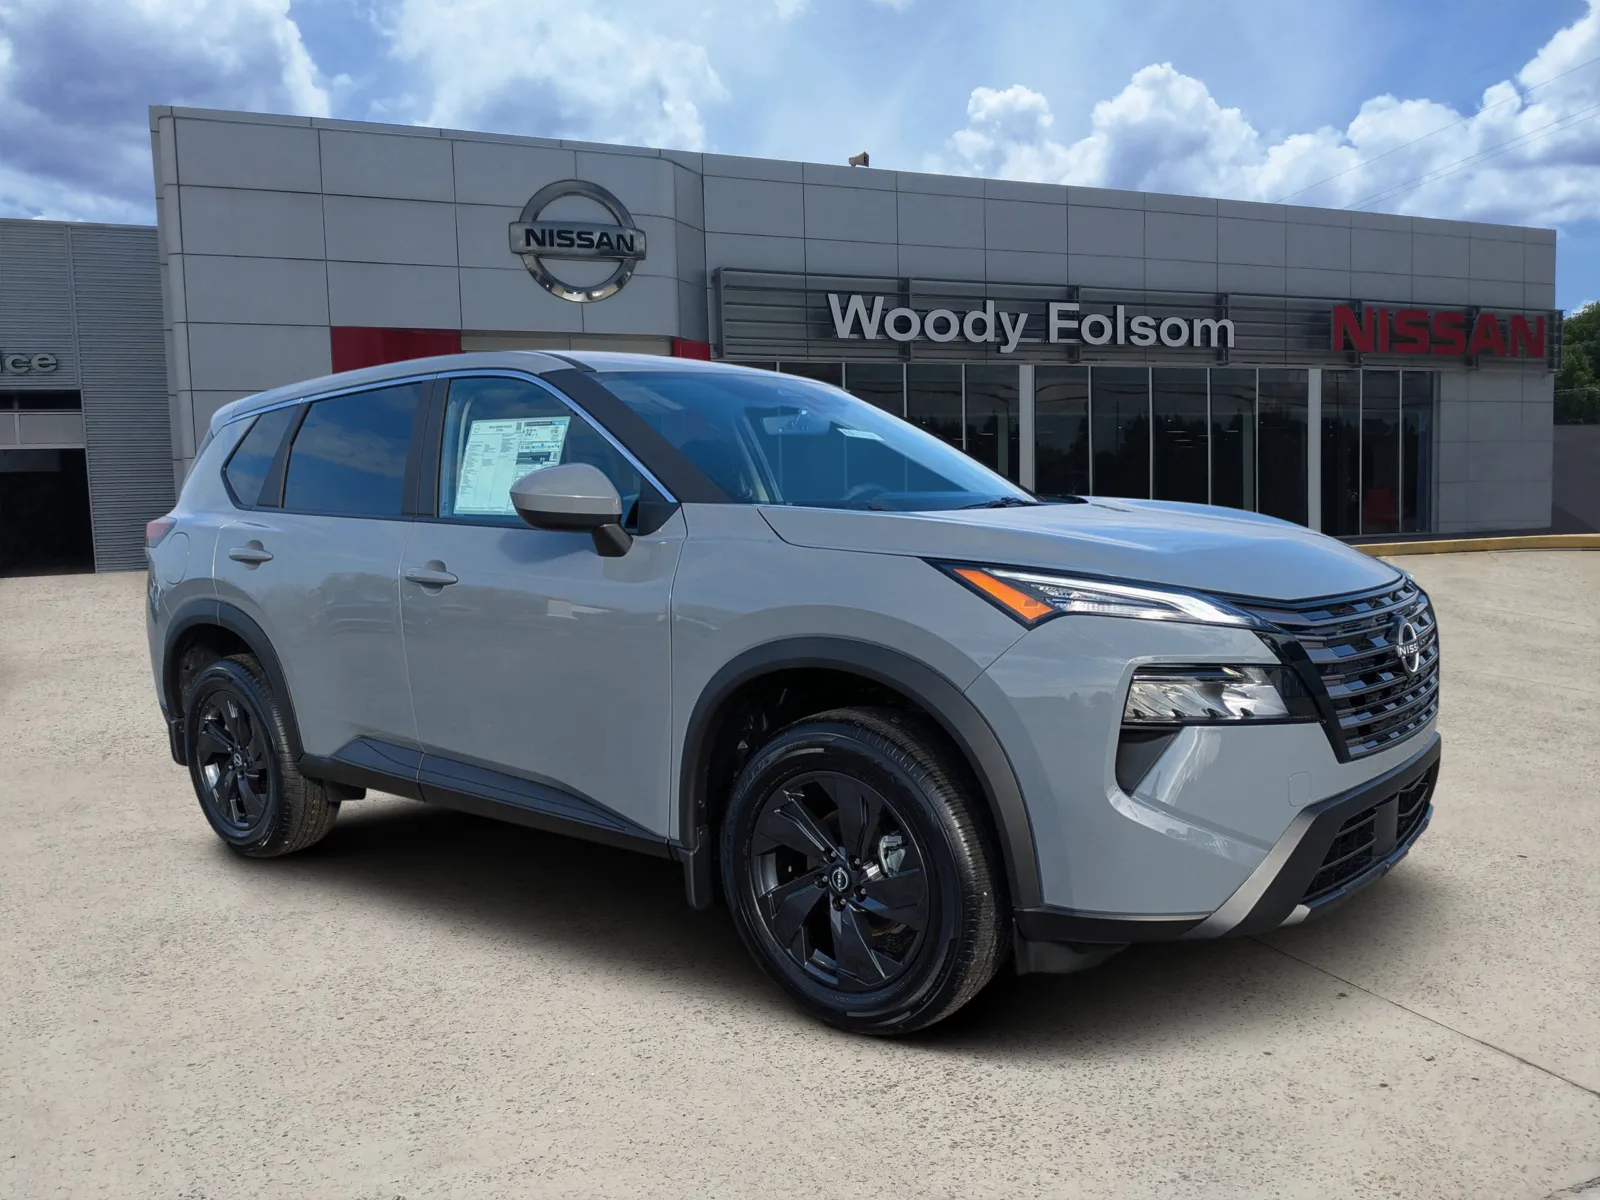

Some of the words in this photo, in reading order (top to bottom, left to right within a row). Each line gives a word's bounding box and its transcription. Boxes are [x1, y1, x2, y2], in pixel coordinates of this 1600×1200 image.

[524, 228, 634, 252] NISSAN
[827, 293, 1028, 353] Woody
[1048, 301, 1235, 348] Folsom
[1333, 304, 1545, 358] NISSAN
[0, 353, 57, 373] ce
[1399, 644, 1418, 655] NISS
